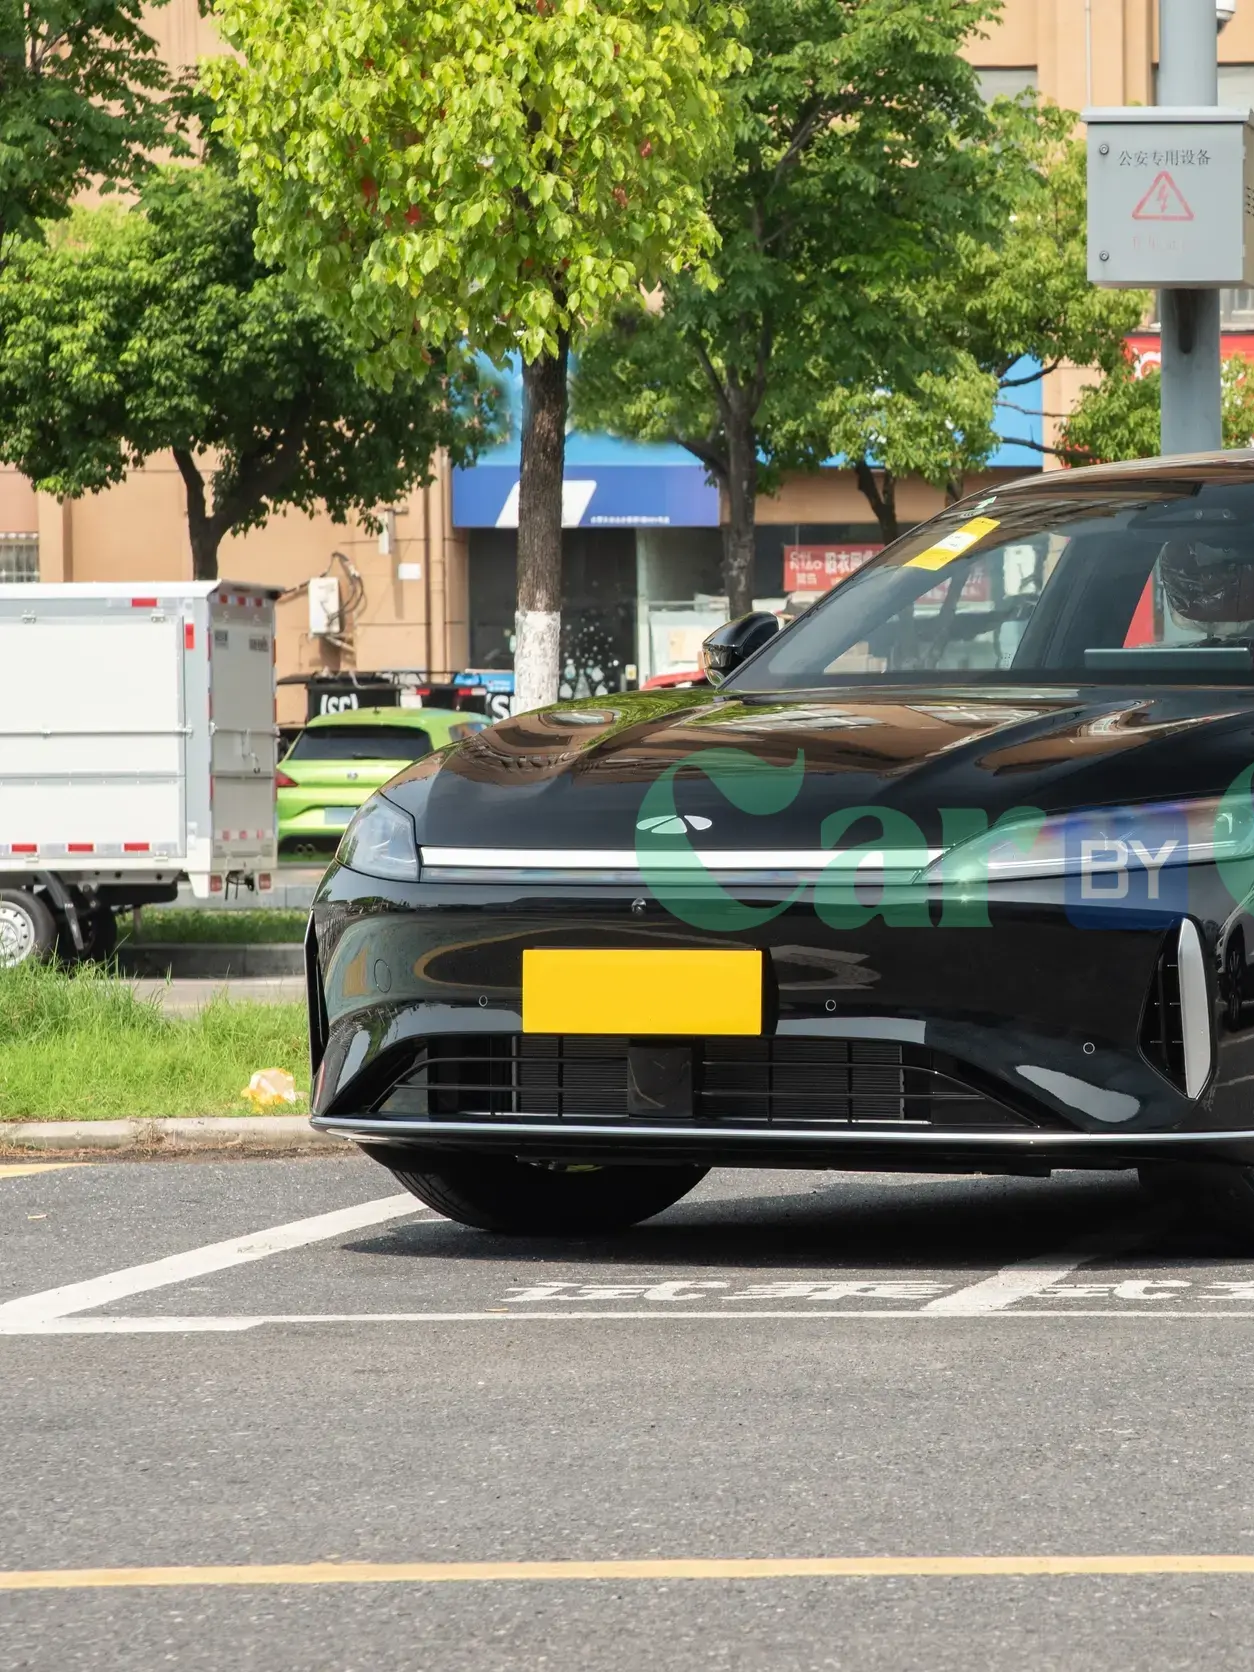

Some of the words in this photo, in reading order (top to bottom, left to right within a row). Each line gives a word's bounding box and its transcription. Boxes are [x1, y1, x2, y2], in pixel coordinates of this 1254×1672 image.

[1118, 149, 1211, 167] 公安专用设备
